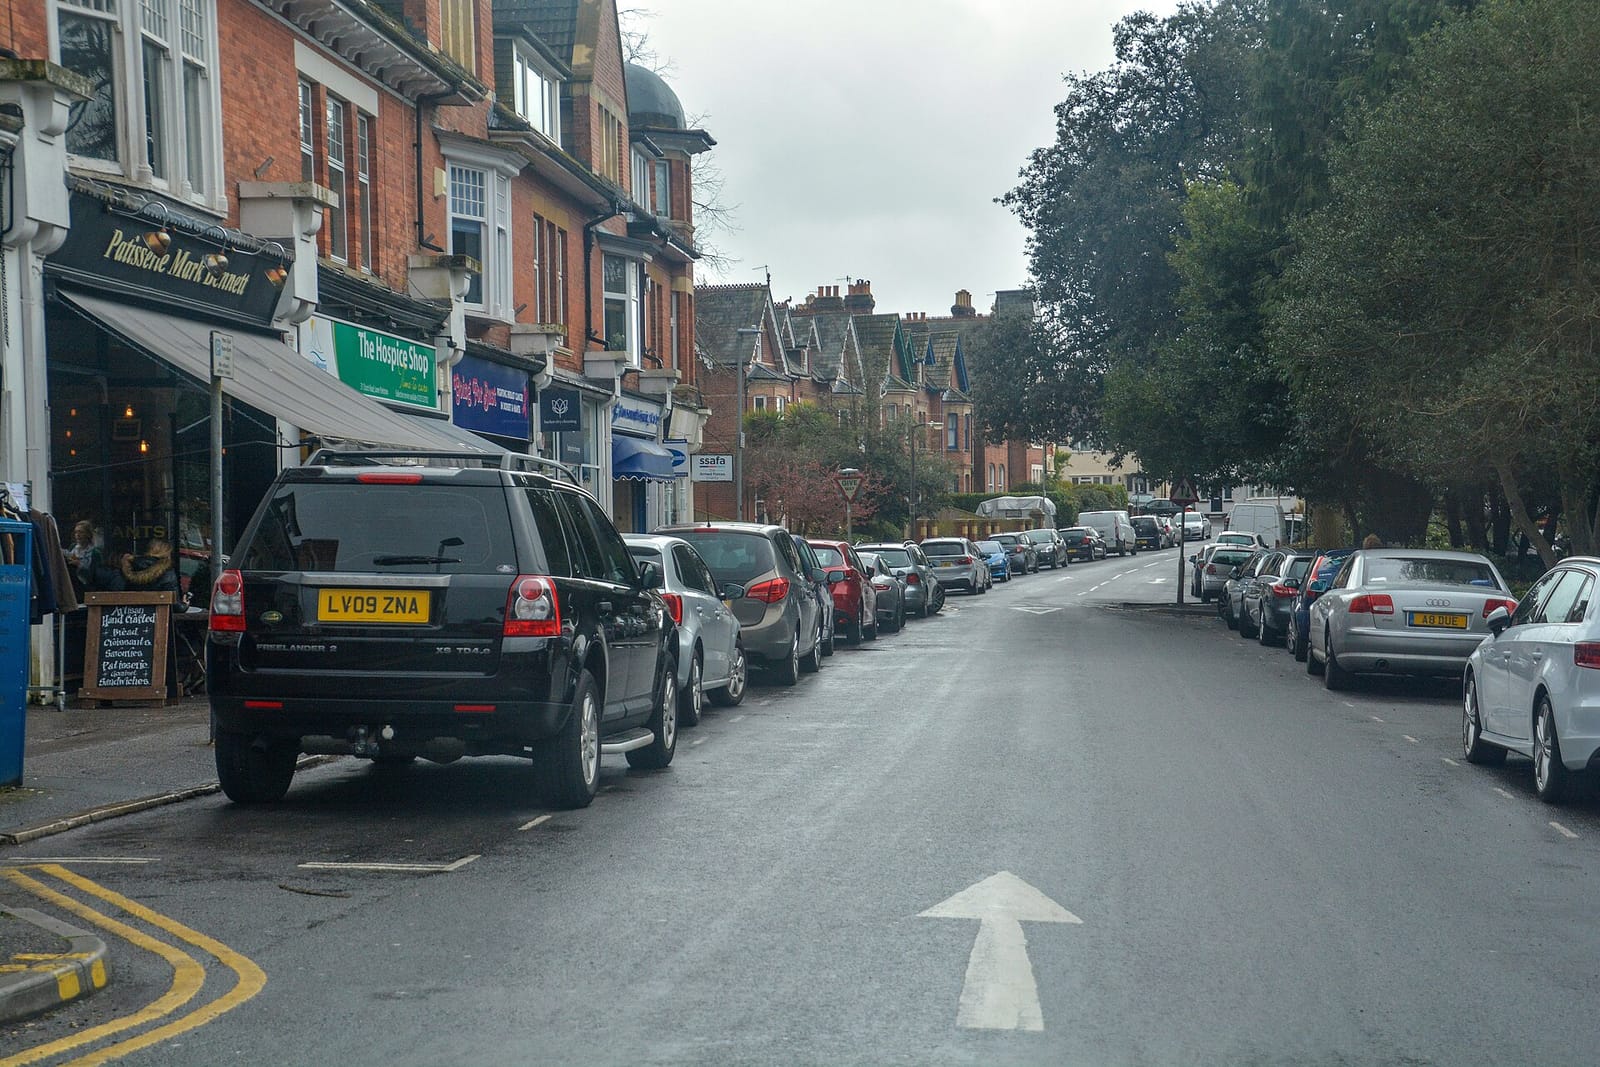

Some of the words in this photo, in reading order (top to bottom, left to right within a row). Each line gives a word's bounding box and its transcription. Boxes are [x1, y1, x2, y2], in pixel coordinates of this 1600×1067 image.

[103, 229, 170, 273] Patisserie
[167, 249, 204, 283] Mark
[358, 331, 374, 360] The
[376, 336, 408, 372] Hospice
[408, 346, 429, 379] Shop
[699, 455, 726, 465] ssafa
[327, 595, 377, 613] LV09
[382, 596, 419, 615] ZNA
[102, 614, 124, 627] Hand
[125, 613, 156, 624] Crafted
[1422, 615, 1435, 625] A8
[1438, 616, 1459, 626] DUE
[112, 627, 139, 637] Bread
[256, 643, 326, 652] FREELANDER
